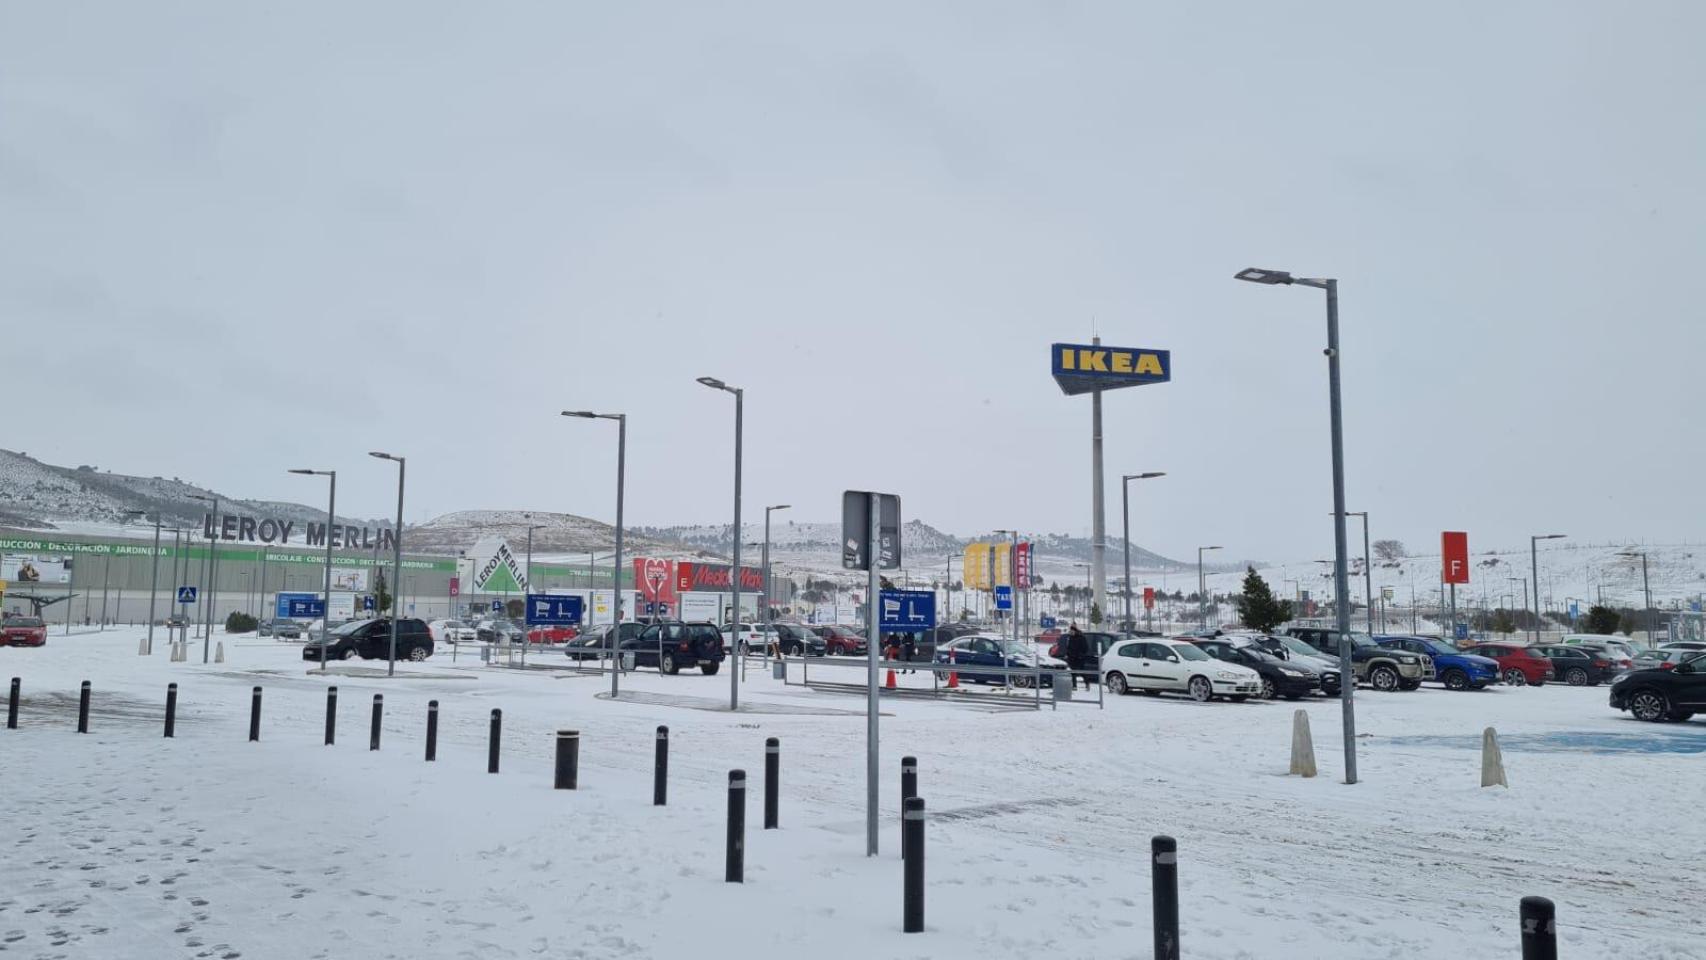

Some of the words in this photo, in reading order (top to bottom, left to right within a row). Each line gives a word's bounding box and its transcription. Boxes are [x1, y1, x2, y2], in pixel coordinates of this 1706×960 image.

[1062, 348, 1164, 375] IKEA
[203, 513, 294, 543] LEROY
[306, 522, 401, 550] MERLIN
[475, 551, 501, 588] LEROY
[499, 544, 528, 591] MERLIN
[1451, 560, 1461, 576] F
[681, 577, 688, 588] E
